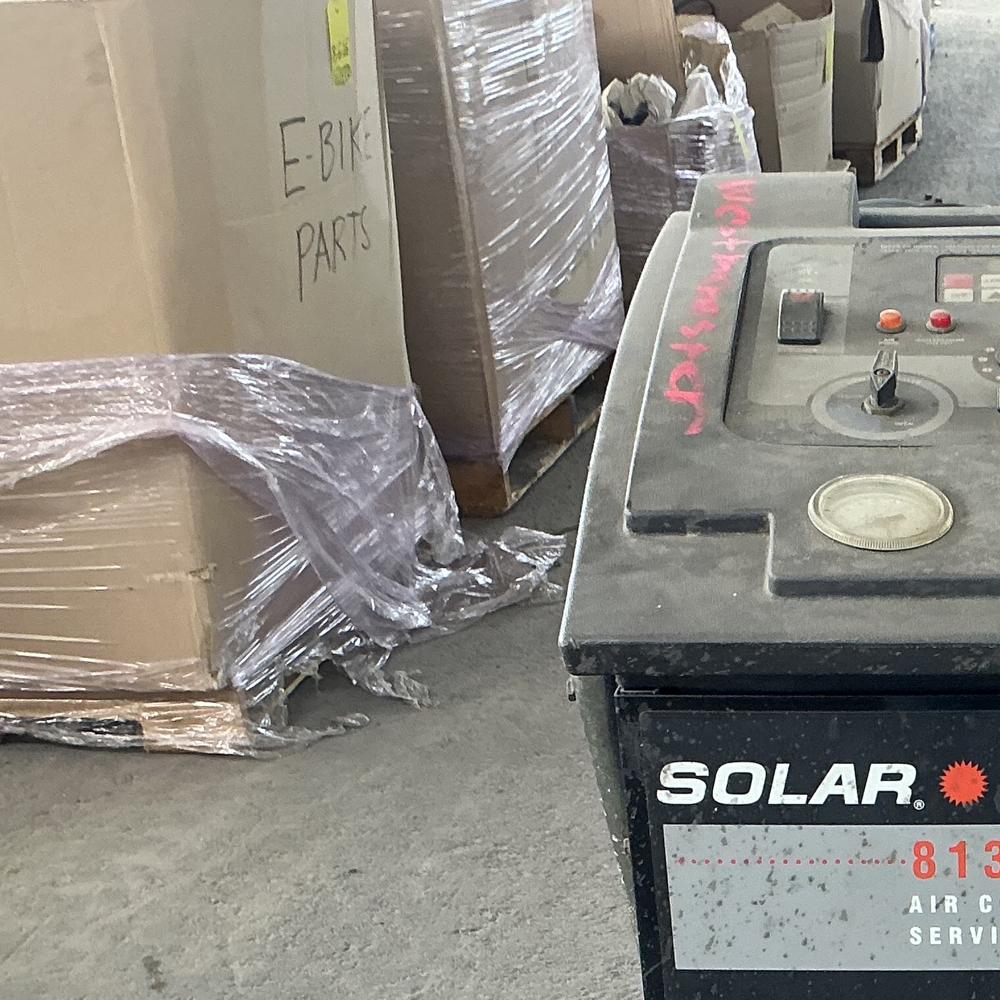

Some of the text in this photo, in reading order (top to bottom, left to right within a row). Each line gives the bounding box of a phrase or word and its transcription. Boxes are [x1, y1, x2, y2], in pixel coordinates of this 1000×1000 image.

[296, 204, 371, 302] PARTS
[656, 761, 918, 806] SOLAR
[908, 894, 959, 914] AIR
